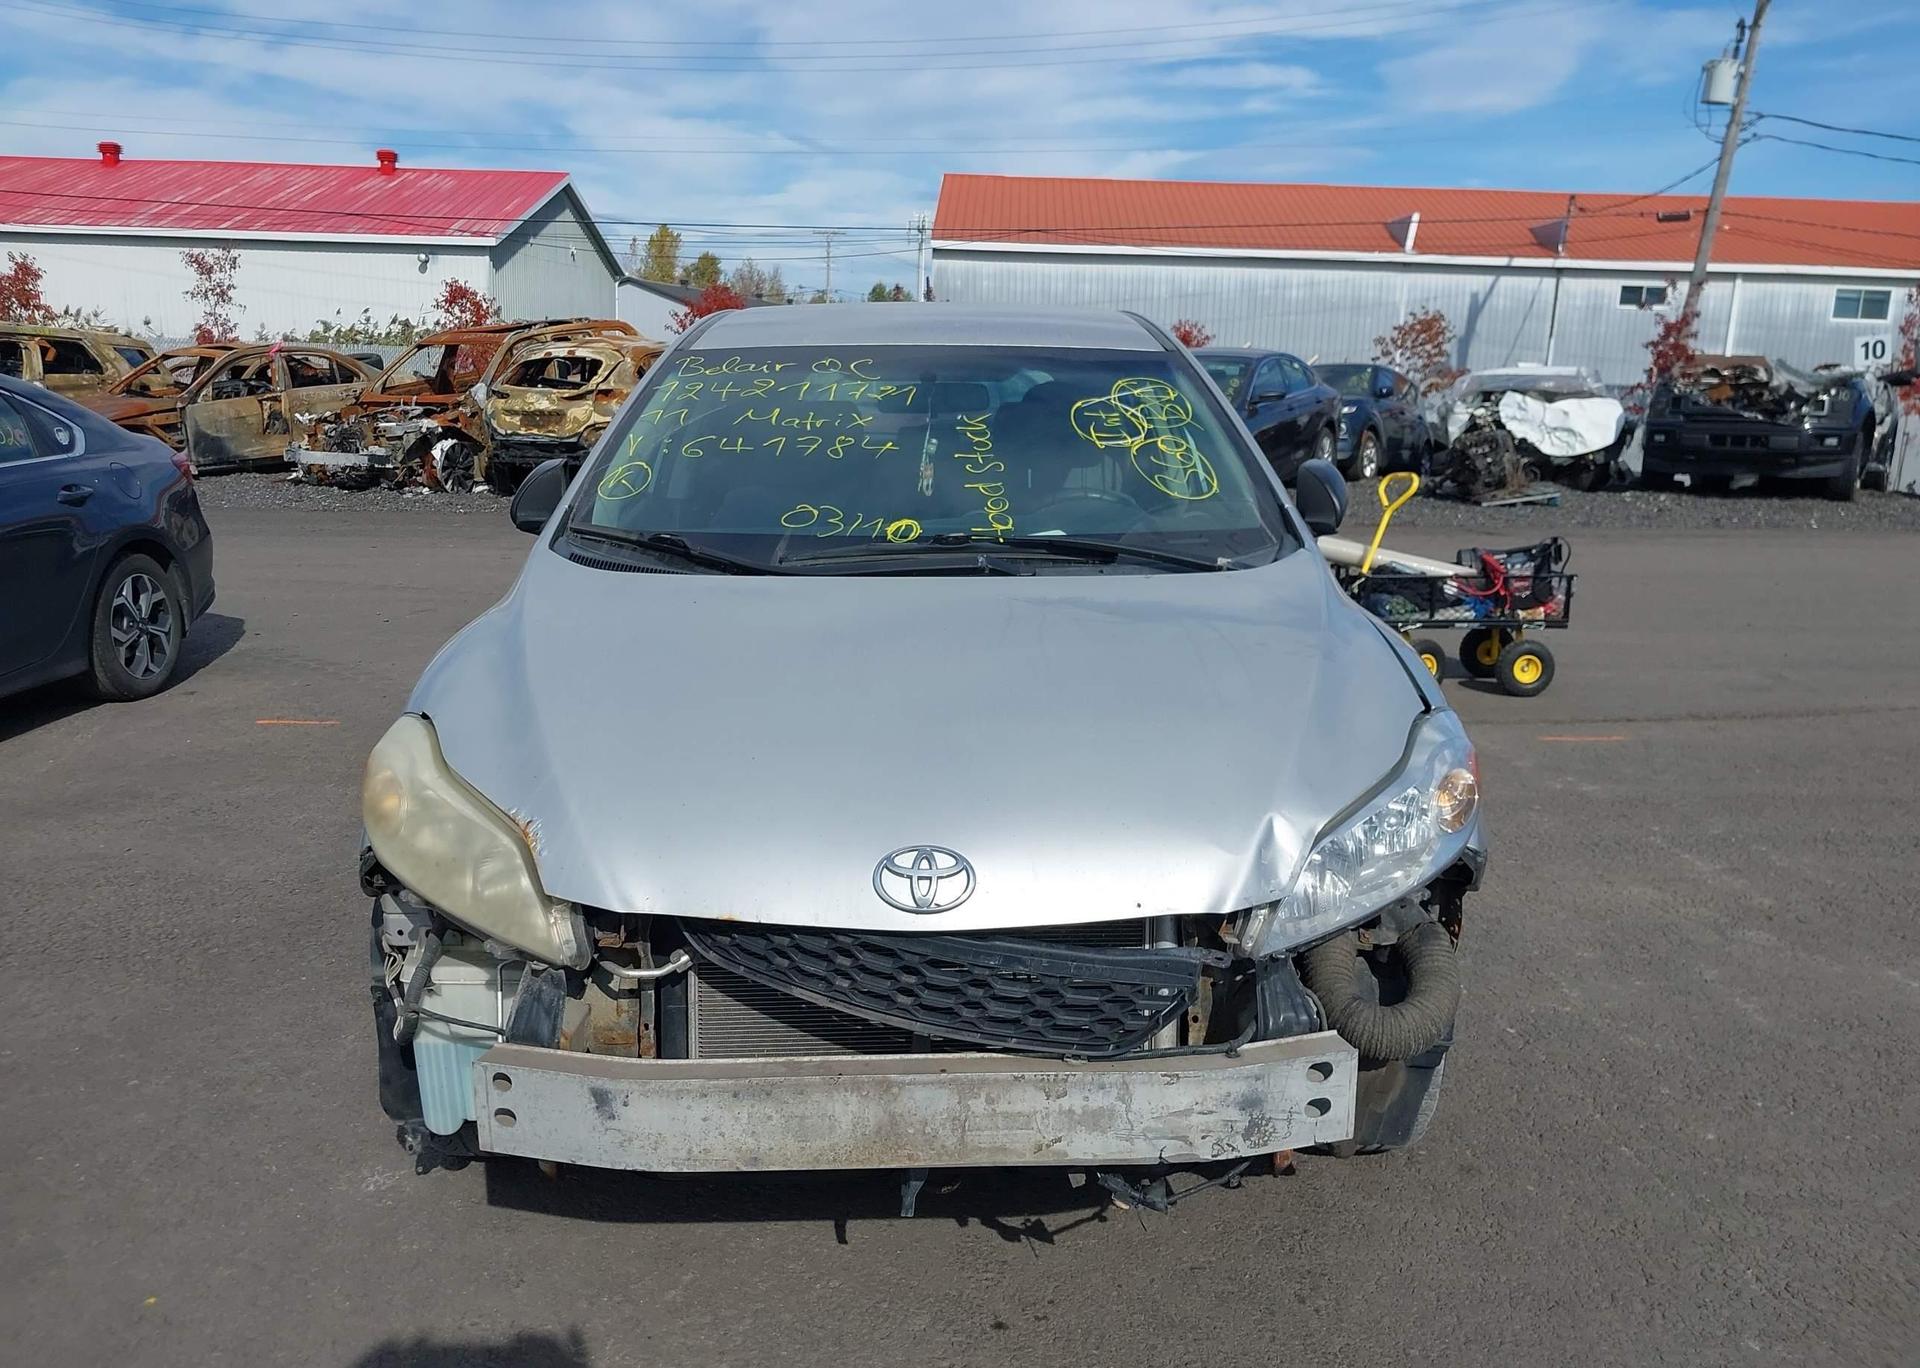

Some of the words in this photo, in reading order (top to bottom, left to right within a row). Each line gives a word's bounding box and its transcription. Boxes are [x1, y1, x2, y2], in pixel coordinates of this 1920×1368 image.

[1860, 339, 1886, 361] 10
[675, 356, 798, 378] Belair
[811, 357, 881, 381] QC
[640, 407, 689, 428] 11
[732, 407, 873, 431] Matrix
